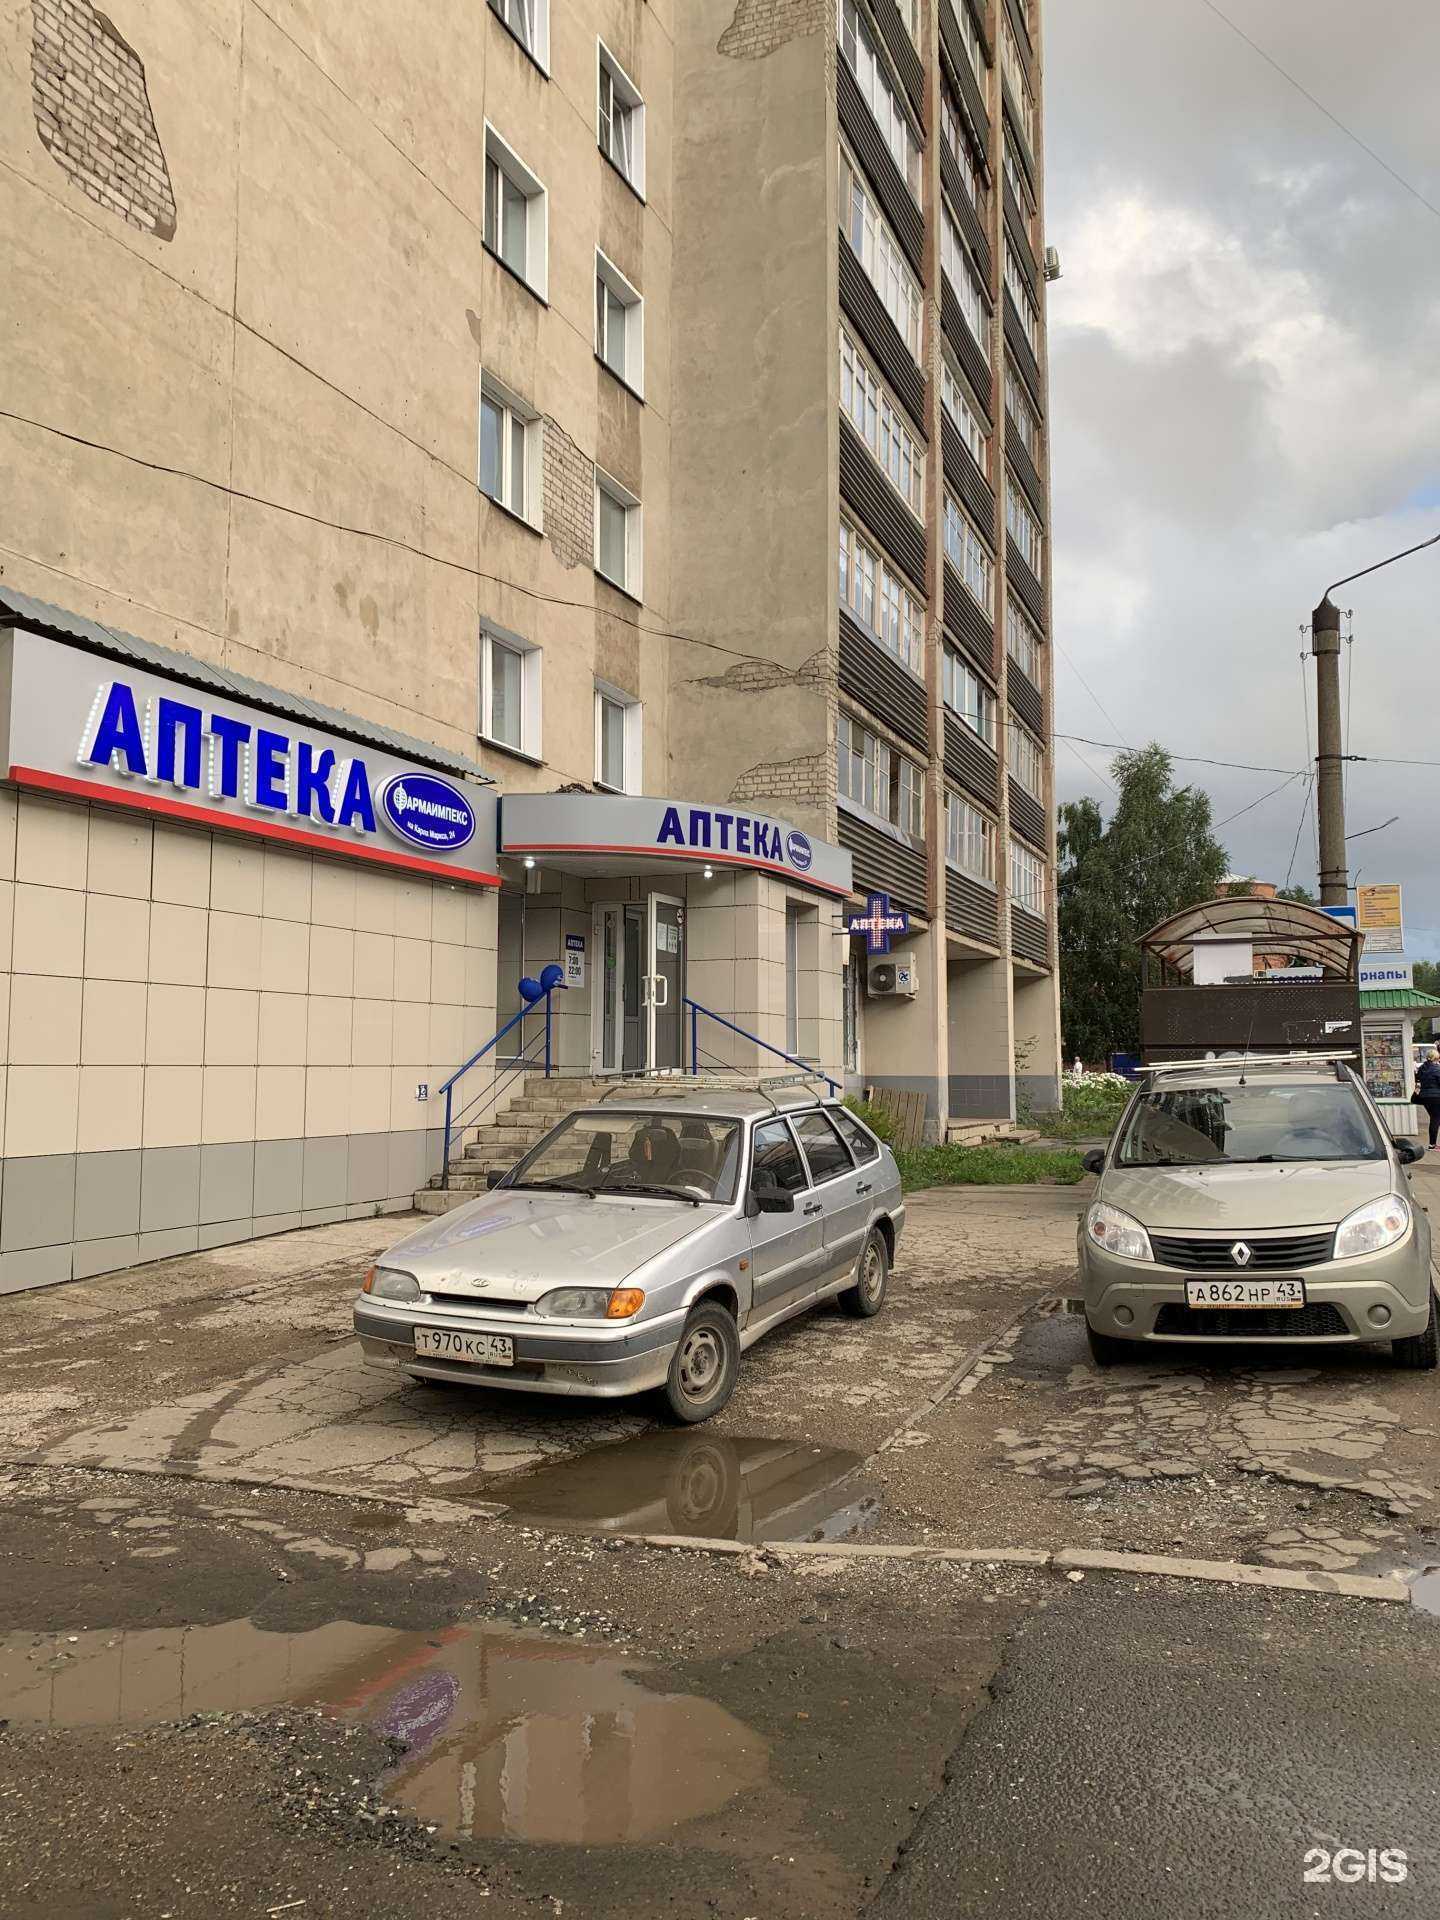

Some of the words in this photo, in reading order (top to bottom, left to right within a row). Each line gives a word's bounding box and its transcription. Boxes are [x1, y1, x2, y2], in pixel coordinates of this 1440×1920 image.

[82, 682, 377, 833] АПТЕКА
[393, 782, 468, 826] ФАРМАИМПЕКС
[657, 807, 783, 862] АПТЕКА
[567, 938, 583, 948] АПТЕКА
[850, 917, 905, 930] АПТЕКА
